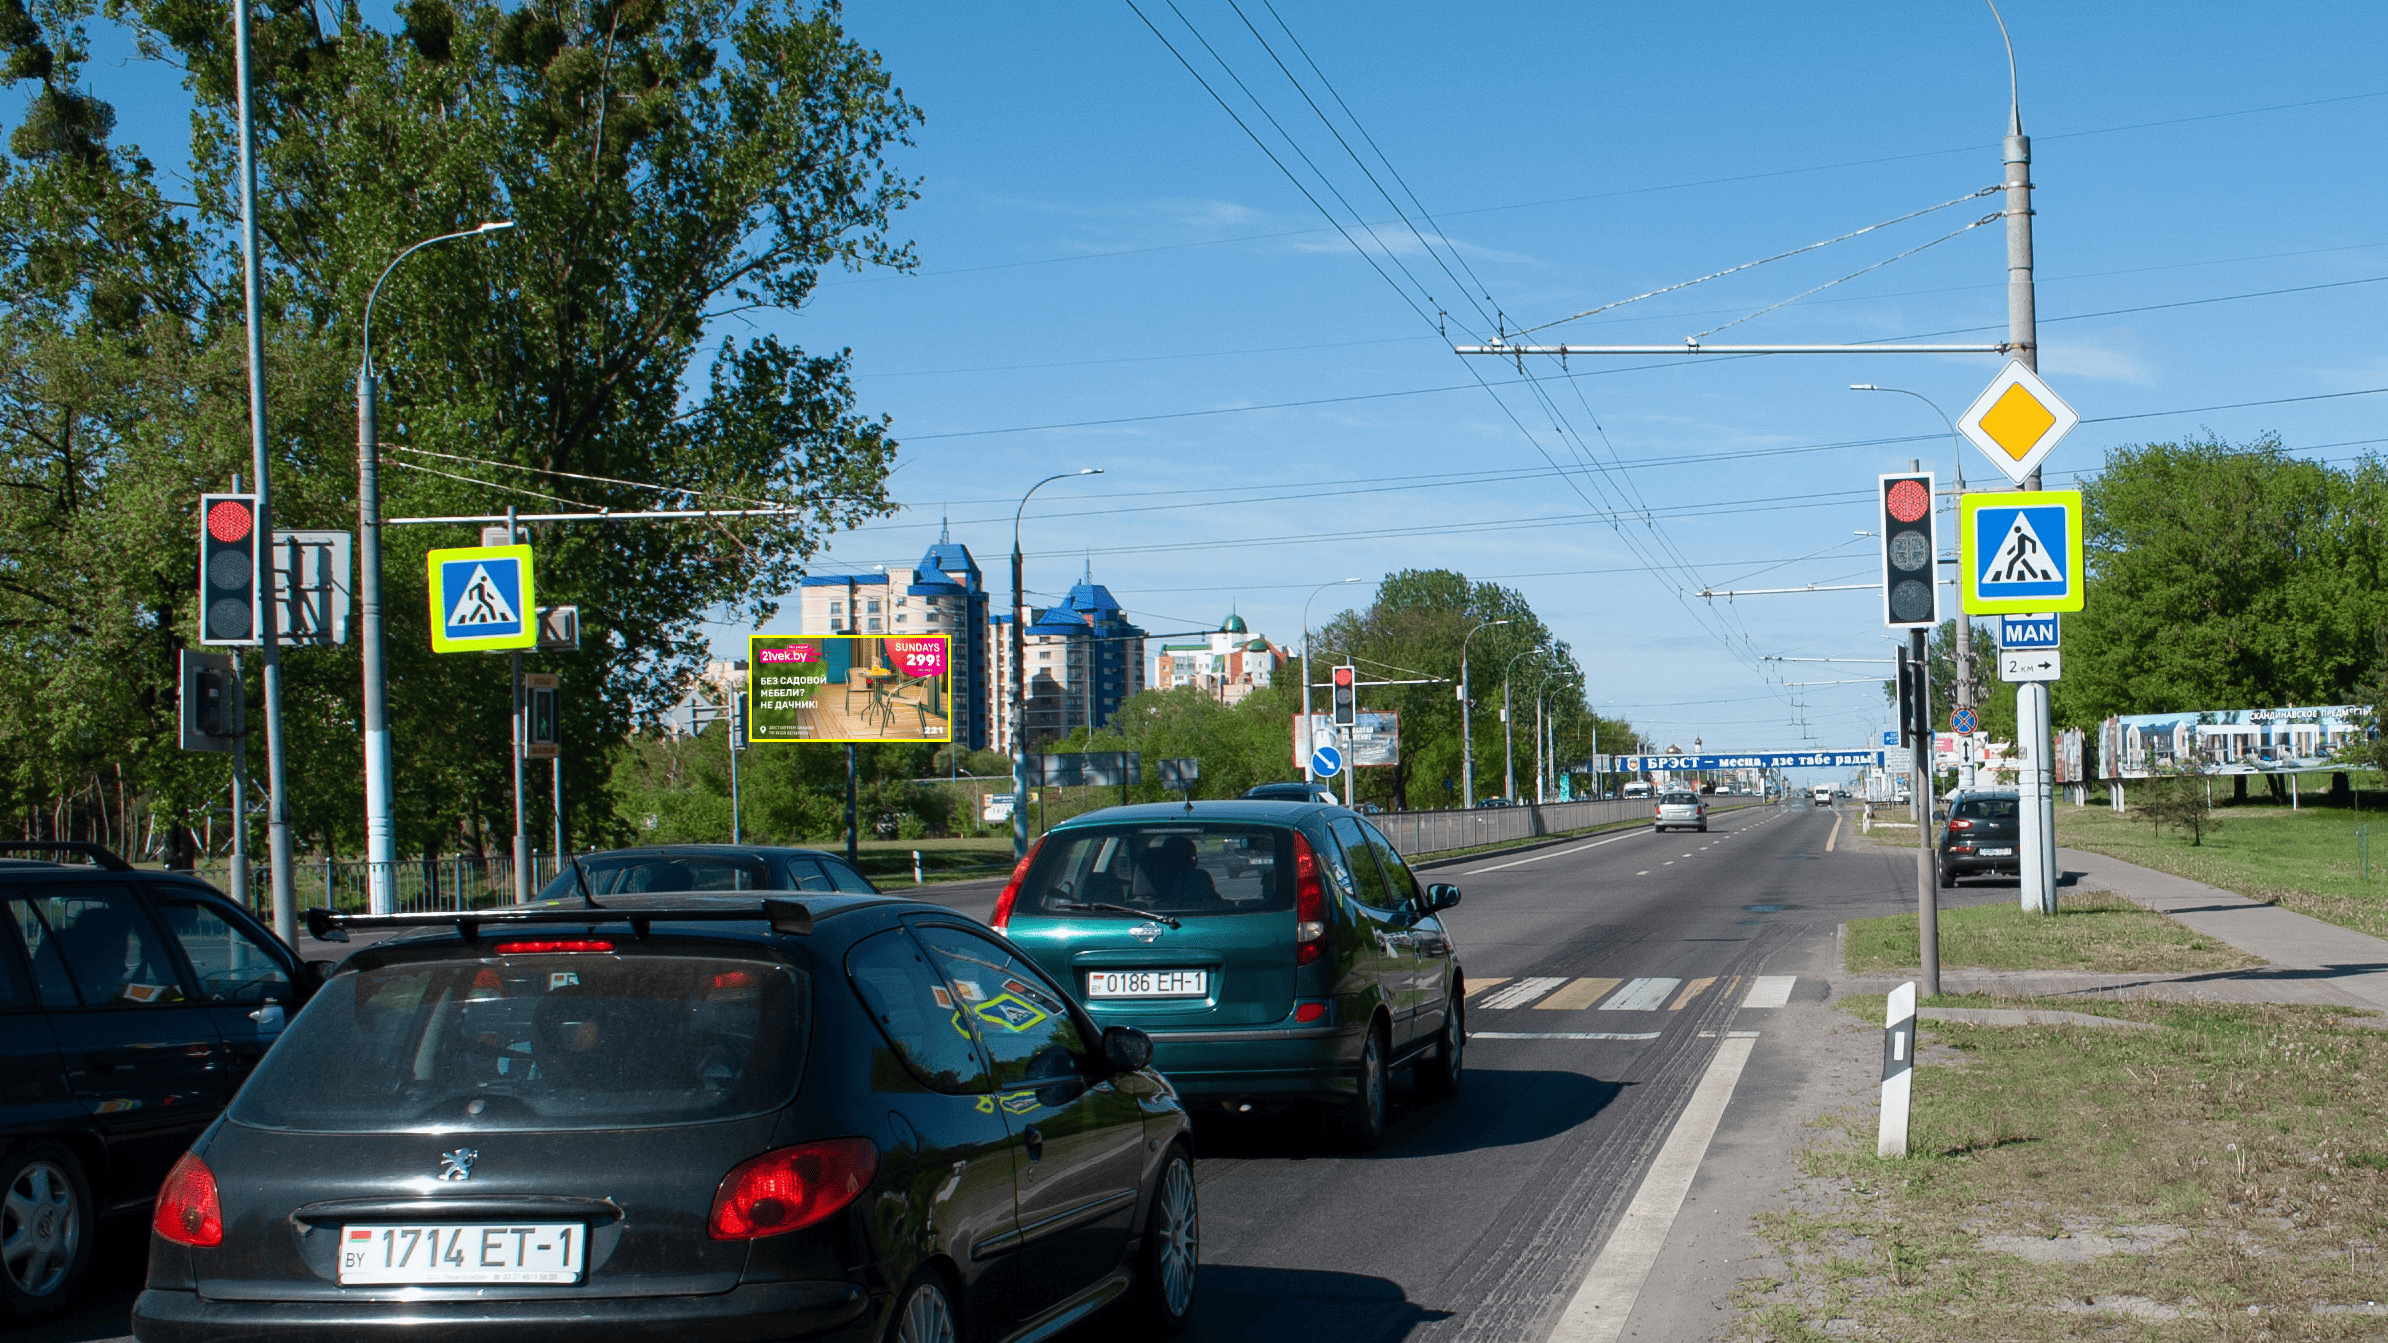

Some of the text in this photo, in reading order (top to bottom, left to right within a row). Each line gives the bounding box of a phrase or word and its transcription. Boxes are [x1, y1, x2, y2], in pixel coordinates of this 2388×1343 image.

[2006, 624, 2054, 642] MAN
[895, 642, 940, 652] SUNDAYS
[762, 651, 807, 662] 21vek.by
[906, 653, 936, 666] 299
[2009, 660, 2018, 673] 2
[760, 674, 827, 686] БЕЗ САДОВОЙ
[760, 688, 805, 697] МЕБЕЛИ?
[760, 700, 818, 711] НЕ ДАЧНИК!
[2249, 709, 2318, 720] СКАНДИНАВСКОЕ
[924, 726, 944, 734] 221
[1647, 756, 1700, 769] БРЭСТ
[1718, 757, 1767, 768] месца,
[1771, 756, 1794, 767] дзе
[1798, 753, 1831, 766] табе
[1107, 972, 1202, 992] 0186 EH-1
[382, 1227, 572, 1268] 1714 ET-1
[345, 1252, 365, 1268] BY
